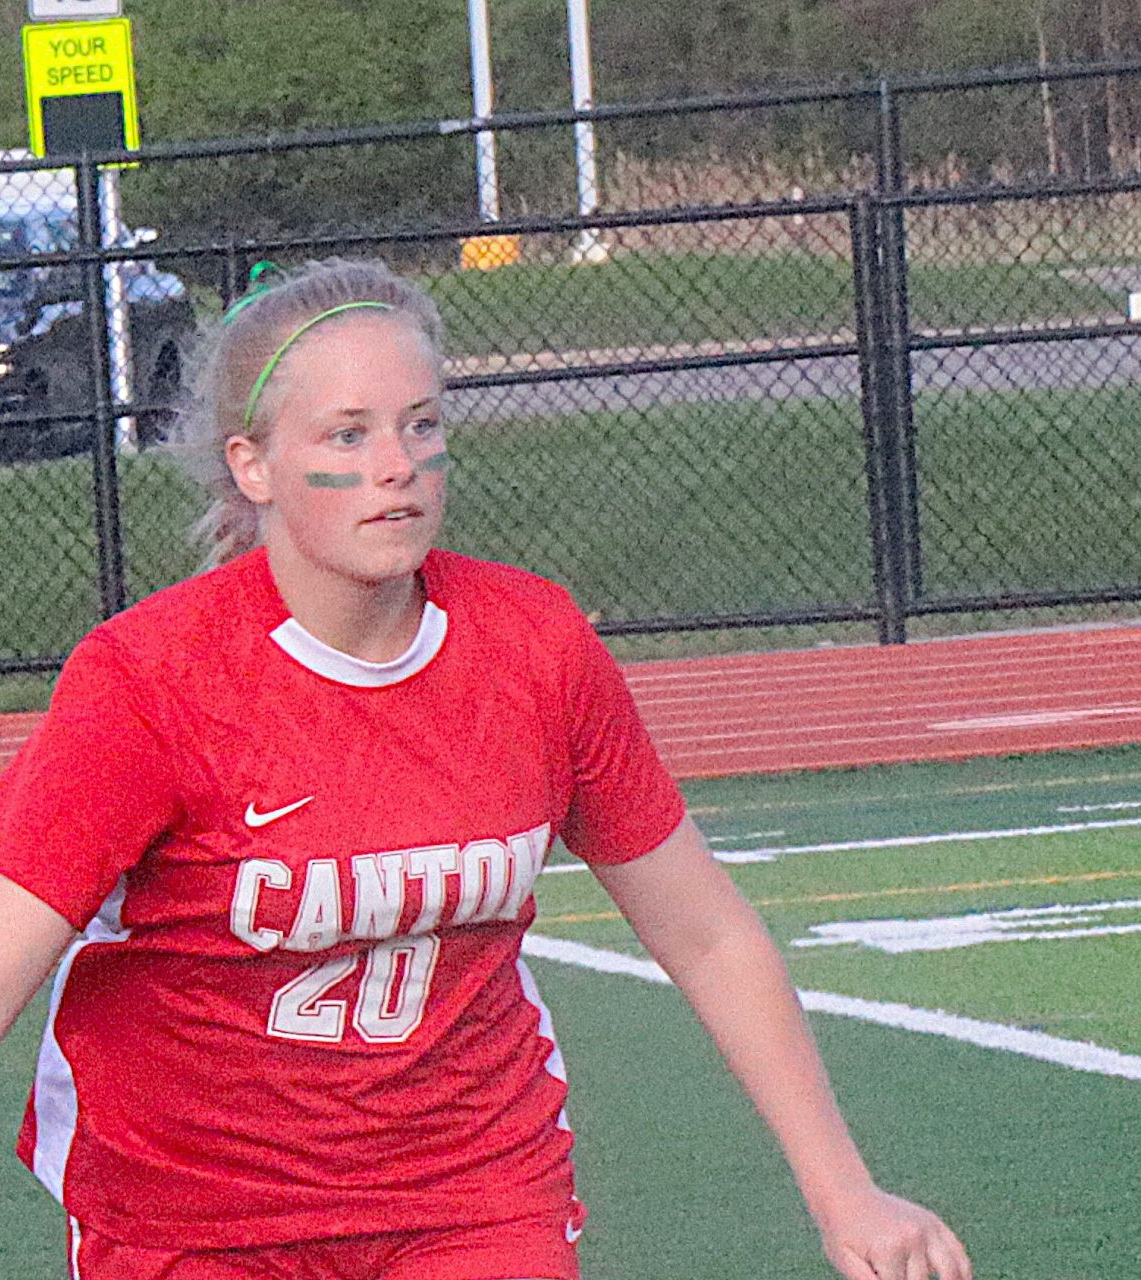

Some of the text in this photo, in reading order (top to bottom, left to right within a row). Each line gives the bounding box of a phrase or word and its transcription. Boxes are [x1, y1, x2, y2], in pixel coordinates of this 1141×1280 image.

[47, 64, 113, 86] SPEED
[49, 37, 106, 58] YOUR
[230, 822, 550, 951] CANTON
[267, 933, 441, 1042] 20
